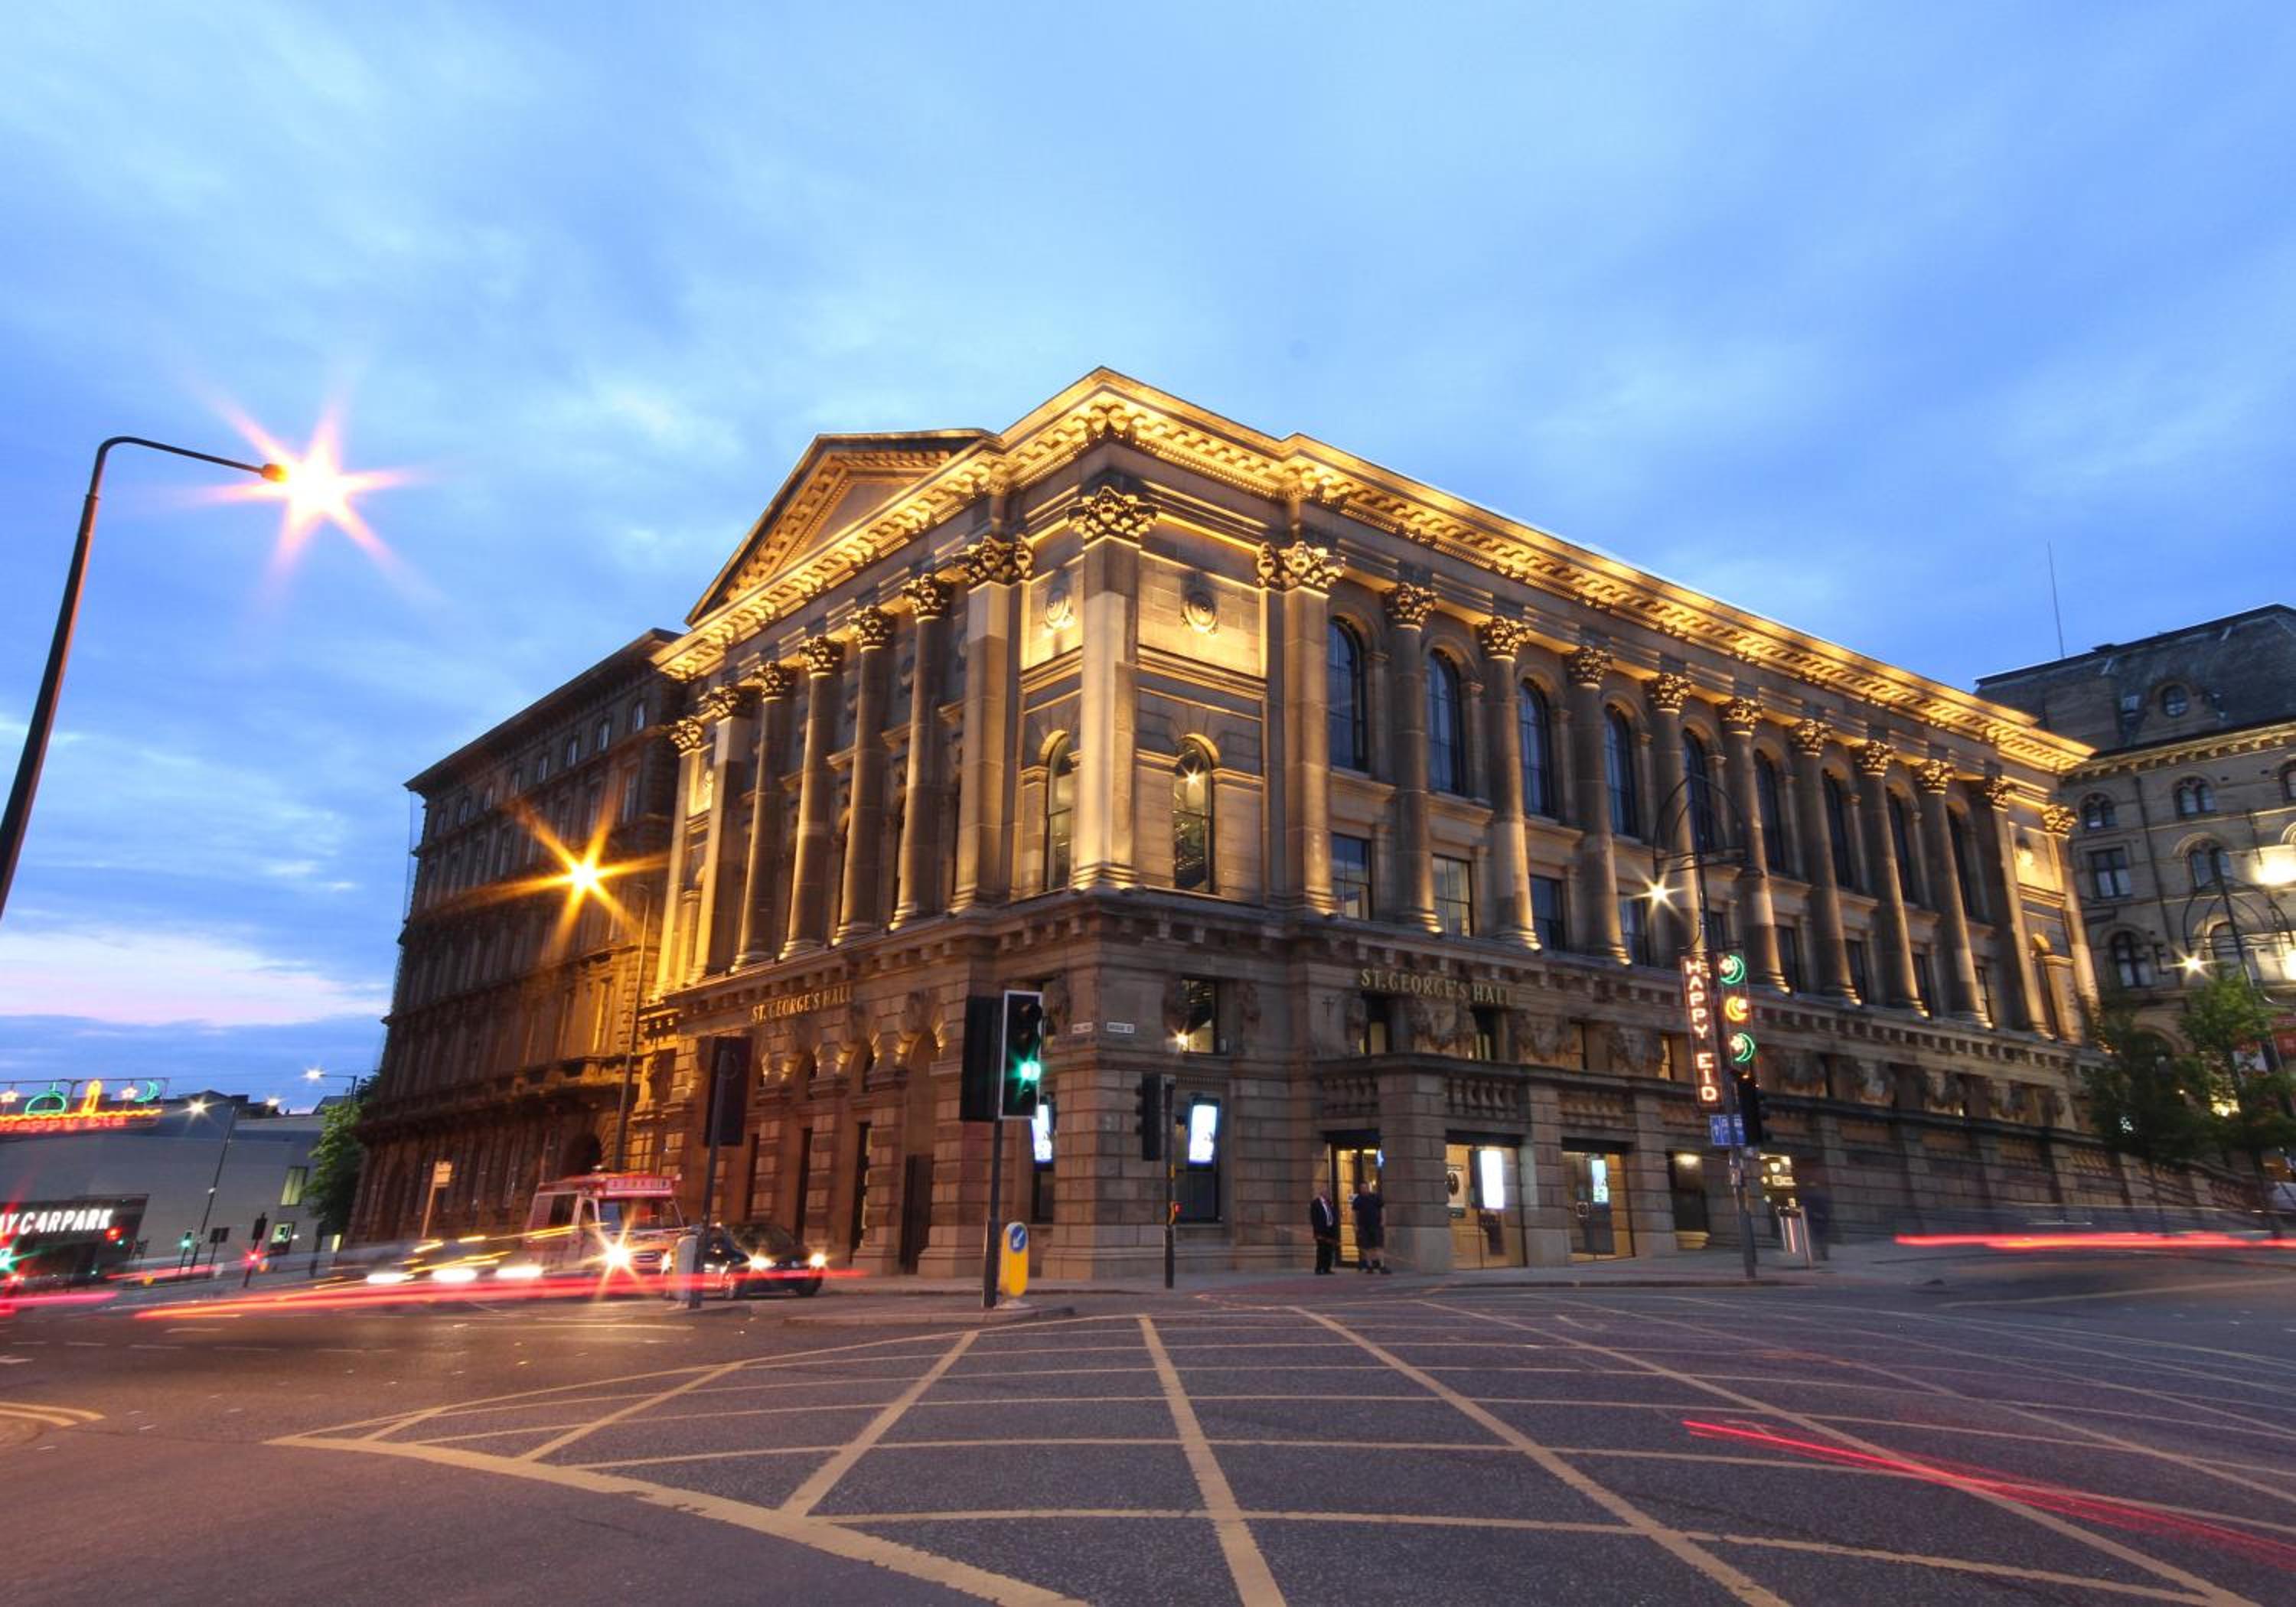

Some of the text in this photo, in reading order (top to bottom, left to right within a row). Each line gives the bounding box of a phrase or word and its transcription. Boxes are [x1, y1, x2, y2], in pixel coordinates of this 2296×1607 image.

[769, 992, 820, 1019] GEORGE'S
[823, 985, 853, 1006] HALL
[1389, 973, 1467, 999] GEORGE'S
[1473, 984, 1516, 1006] HALL
[1684, 959, 1718, 1103] HAPPY EID
[19, 1208, 113, 1235] CARPARK
